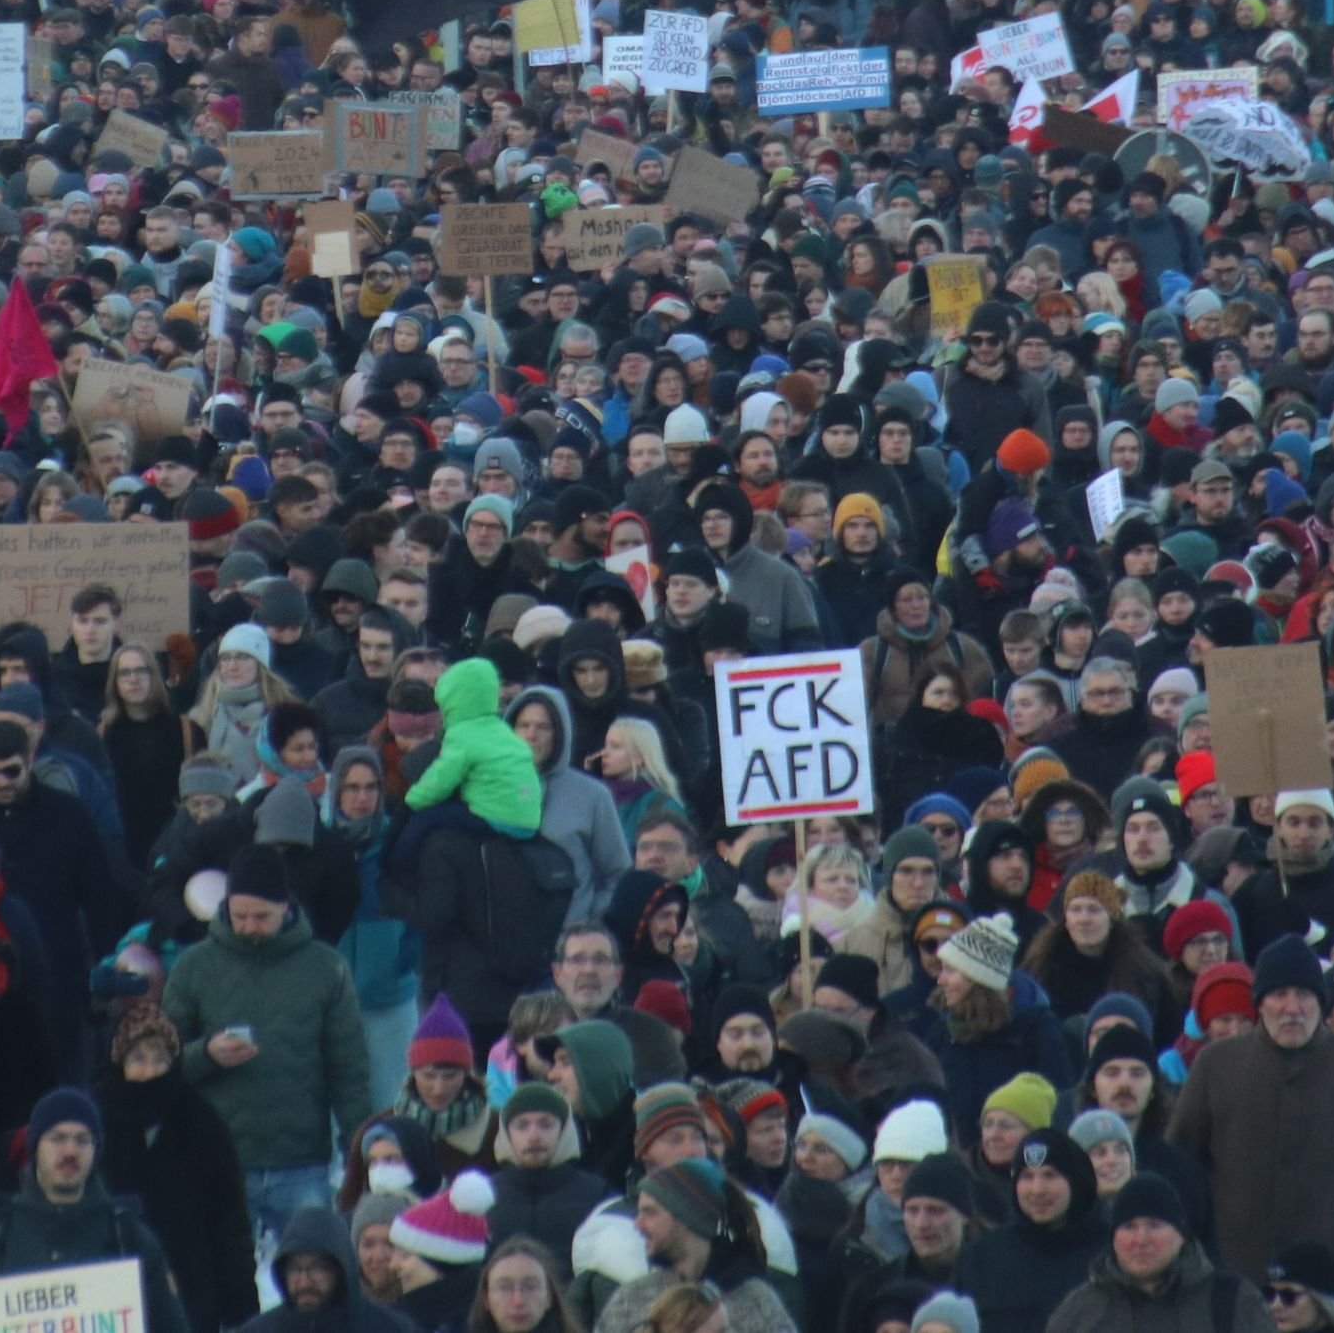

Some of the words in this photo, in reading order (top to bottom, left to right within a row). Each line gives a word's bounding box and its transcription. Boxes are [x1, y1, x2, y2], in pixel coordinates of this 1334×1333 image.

[648, 14, 677, 30] ZUR
[680, 18, 704, 34] AFD
[998, 22, 1030, 41] LIEBER
[654, 30, 668, 44] IST
[670, 31, 695, 45] KEIN
[651, 42, 702, 60] ABSTAND
[831, 51, 858, 62] dem
[648, 58, 665, 72] ZU
[862, 61, 883, 72] der
[729, 677, 854, 737] FCK
[737, 739, 859, 805] AFD
[4, 1284, 77, 1317] LIEBER
